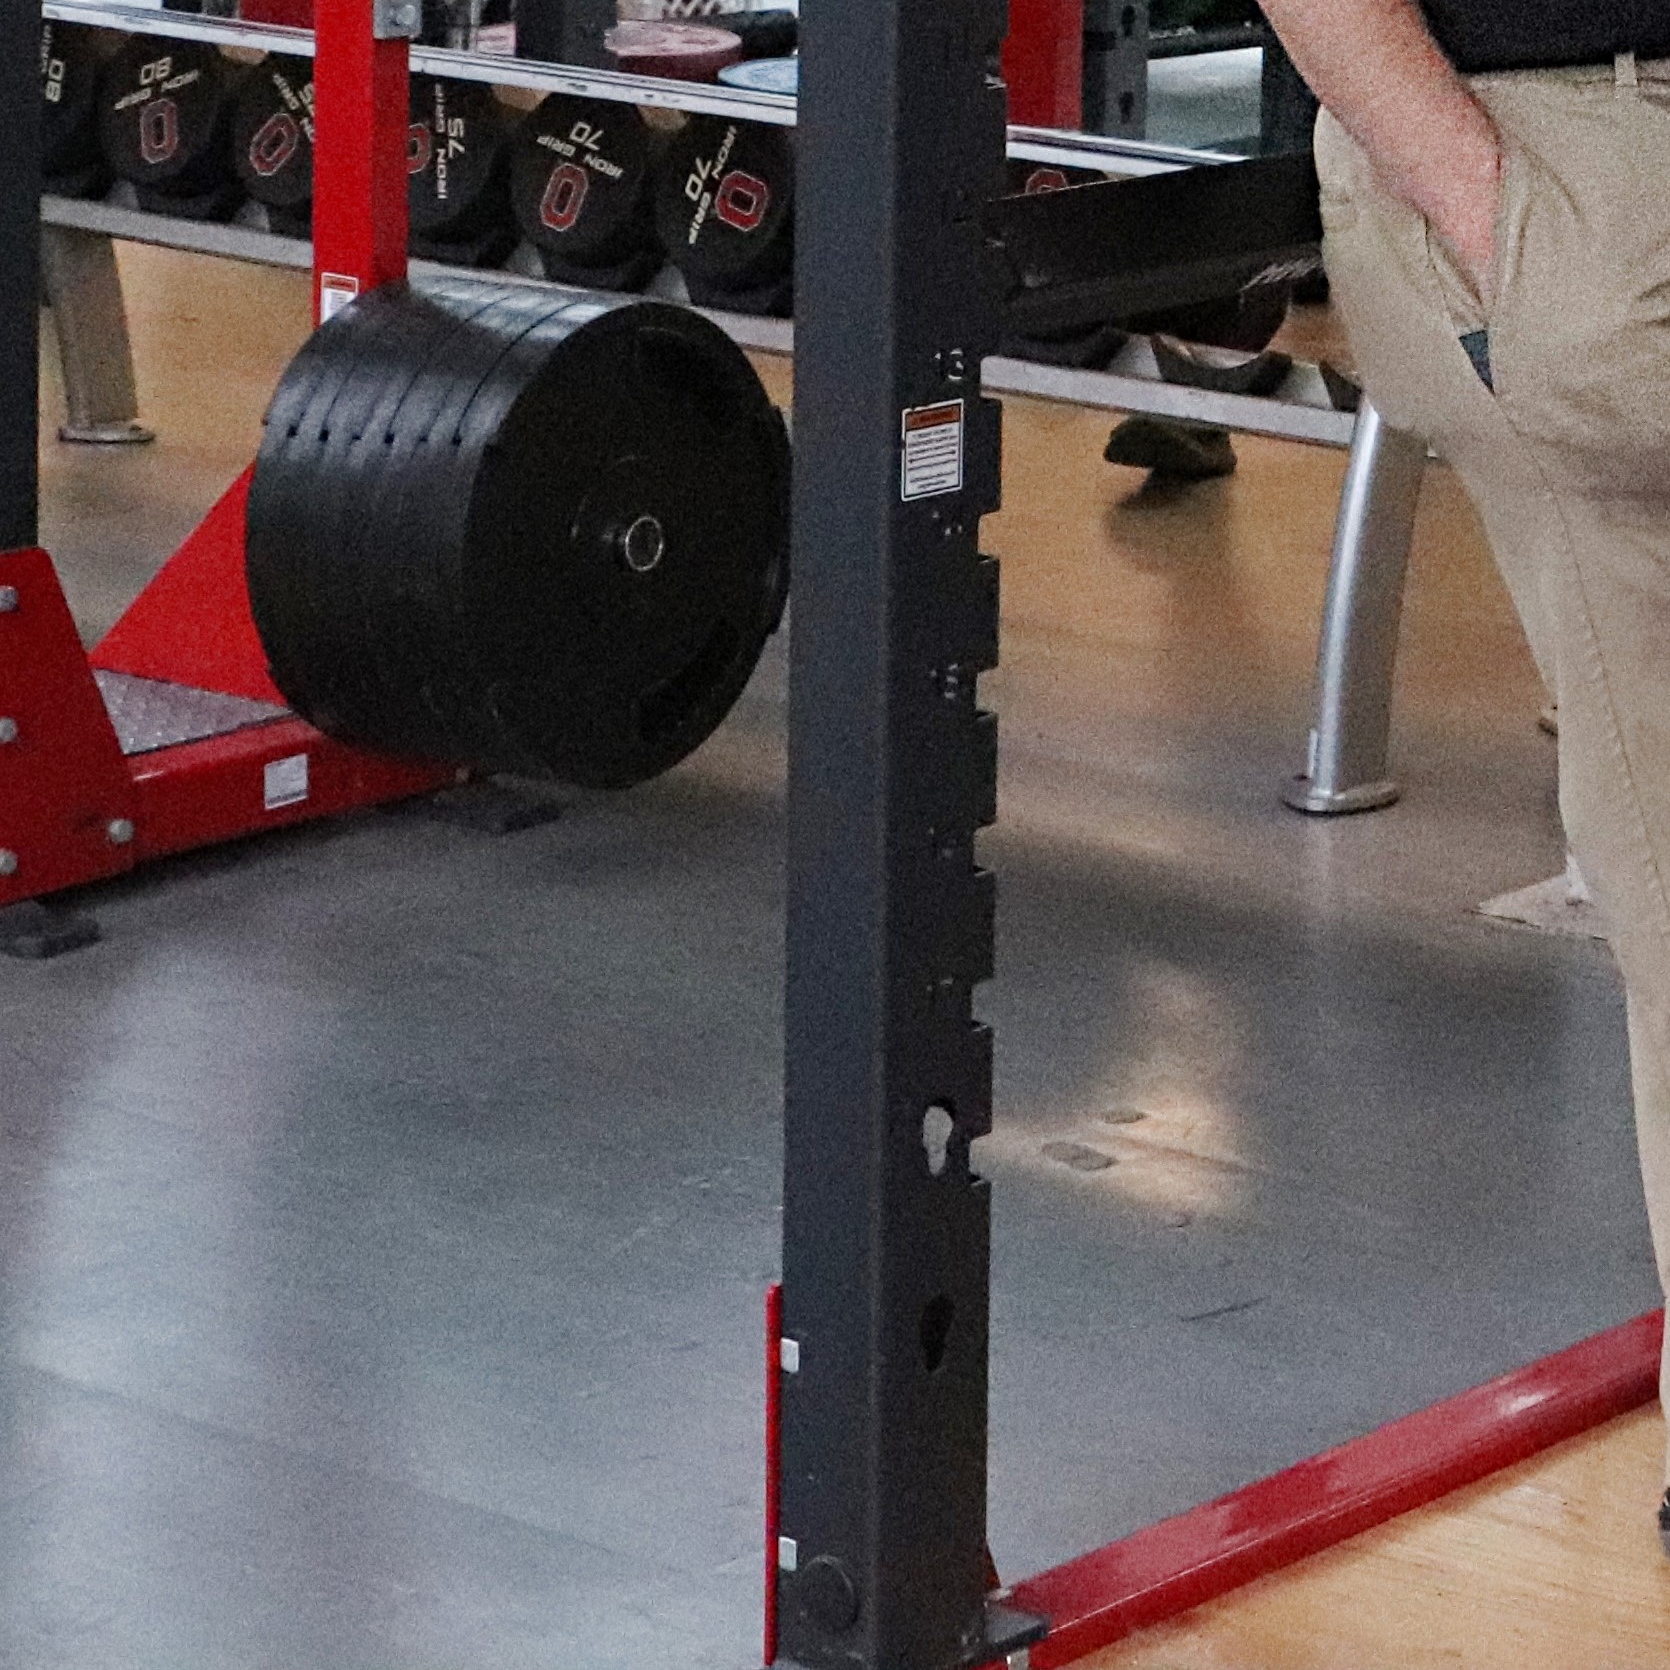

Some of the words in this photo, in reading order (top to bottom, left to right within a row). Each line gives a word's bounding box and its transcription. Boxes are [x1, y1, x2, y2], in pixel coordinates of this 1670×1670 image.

[140, 56, 172, 86] 80
[447, 117, 466, 159] 75
[568, 120, 605, 151] 70
[710, 125, 738, 180] IRON
[584, 153, 625, 179] IRON
[684, 156, 713, 202] 70
